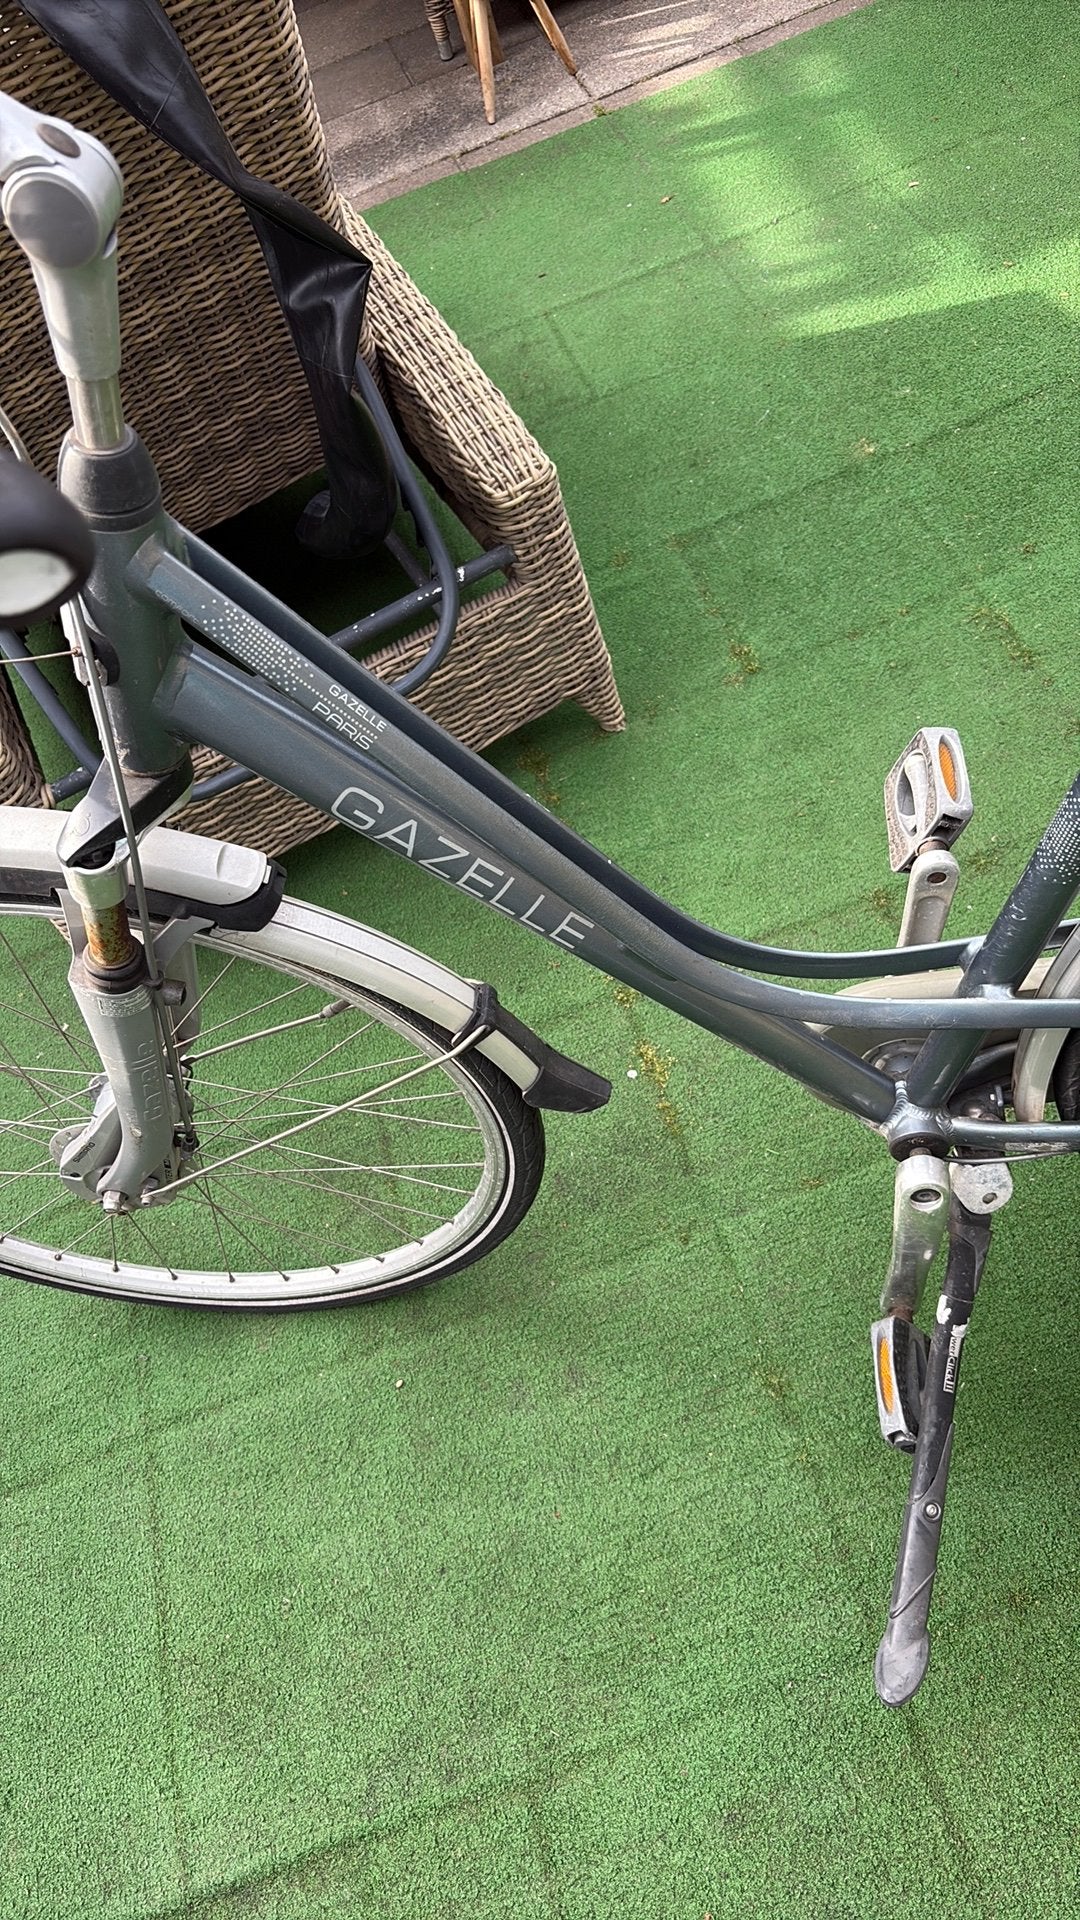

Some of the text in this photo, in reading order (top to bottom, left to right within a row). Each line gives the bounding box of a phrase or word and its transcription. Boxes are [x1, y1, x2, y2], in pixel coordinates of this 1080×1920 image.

[312, 701, 374, 751] PARIS
[328, 684, 387, 733] GAZELLE
[331, 786, 595, 949] GAZELLE
